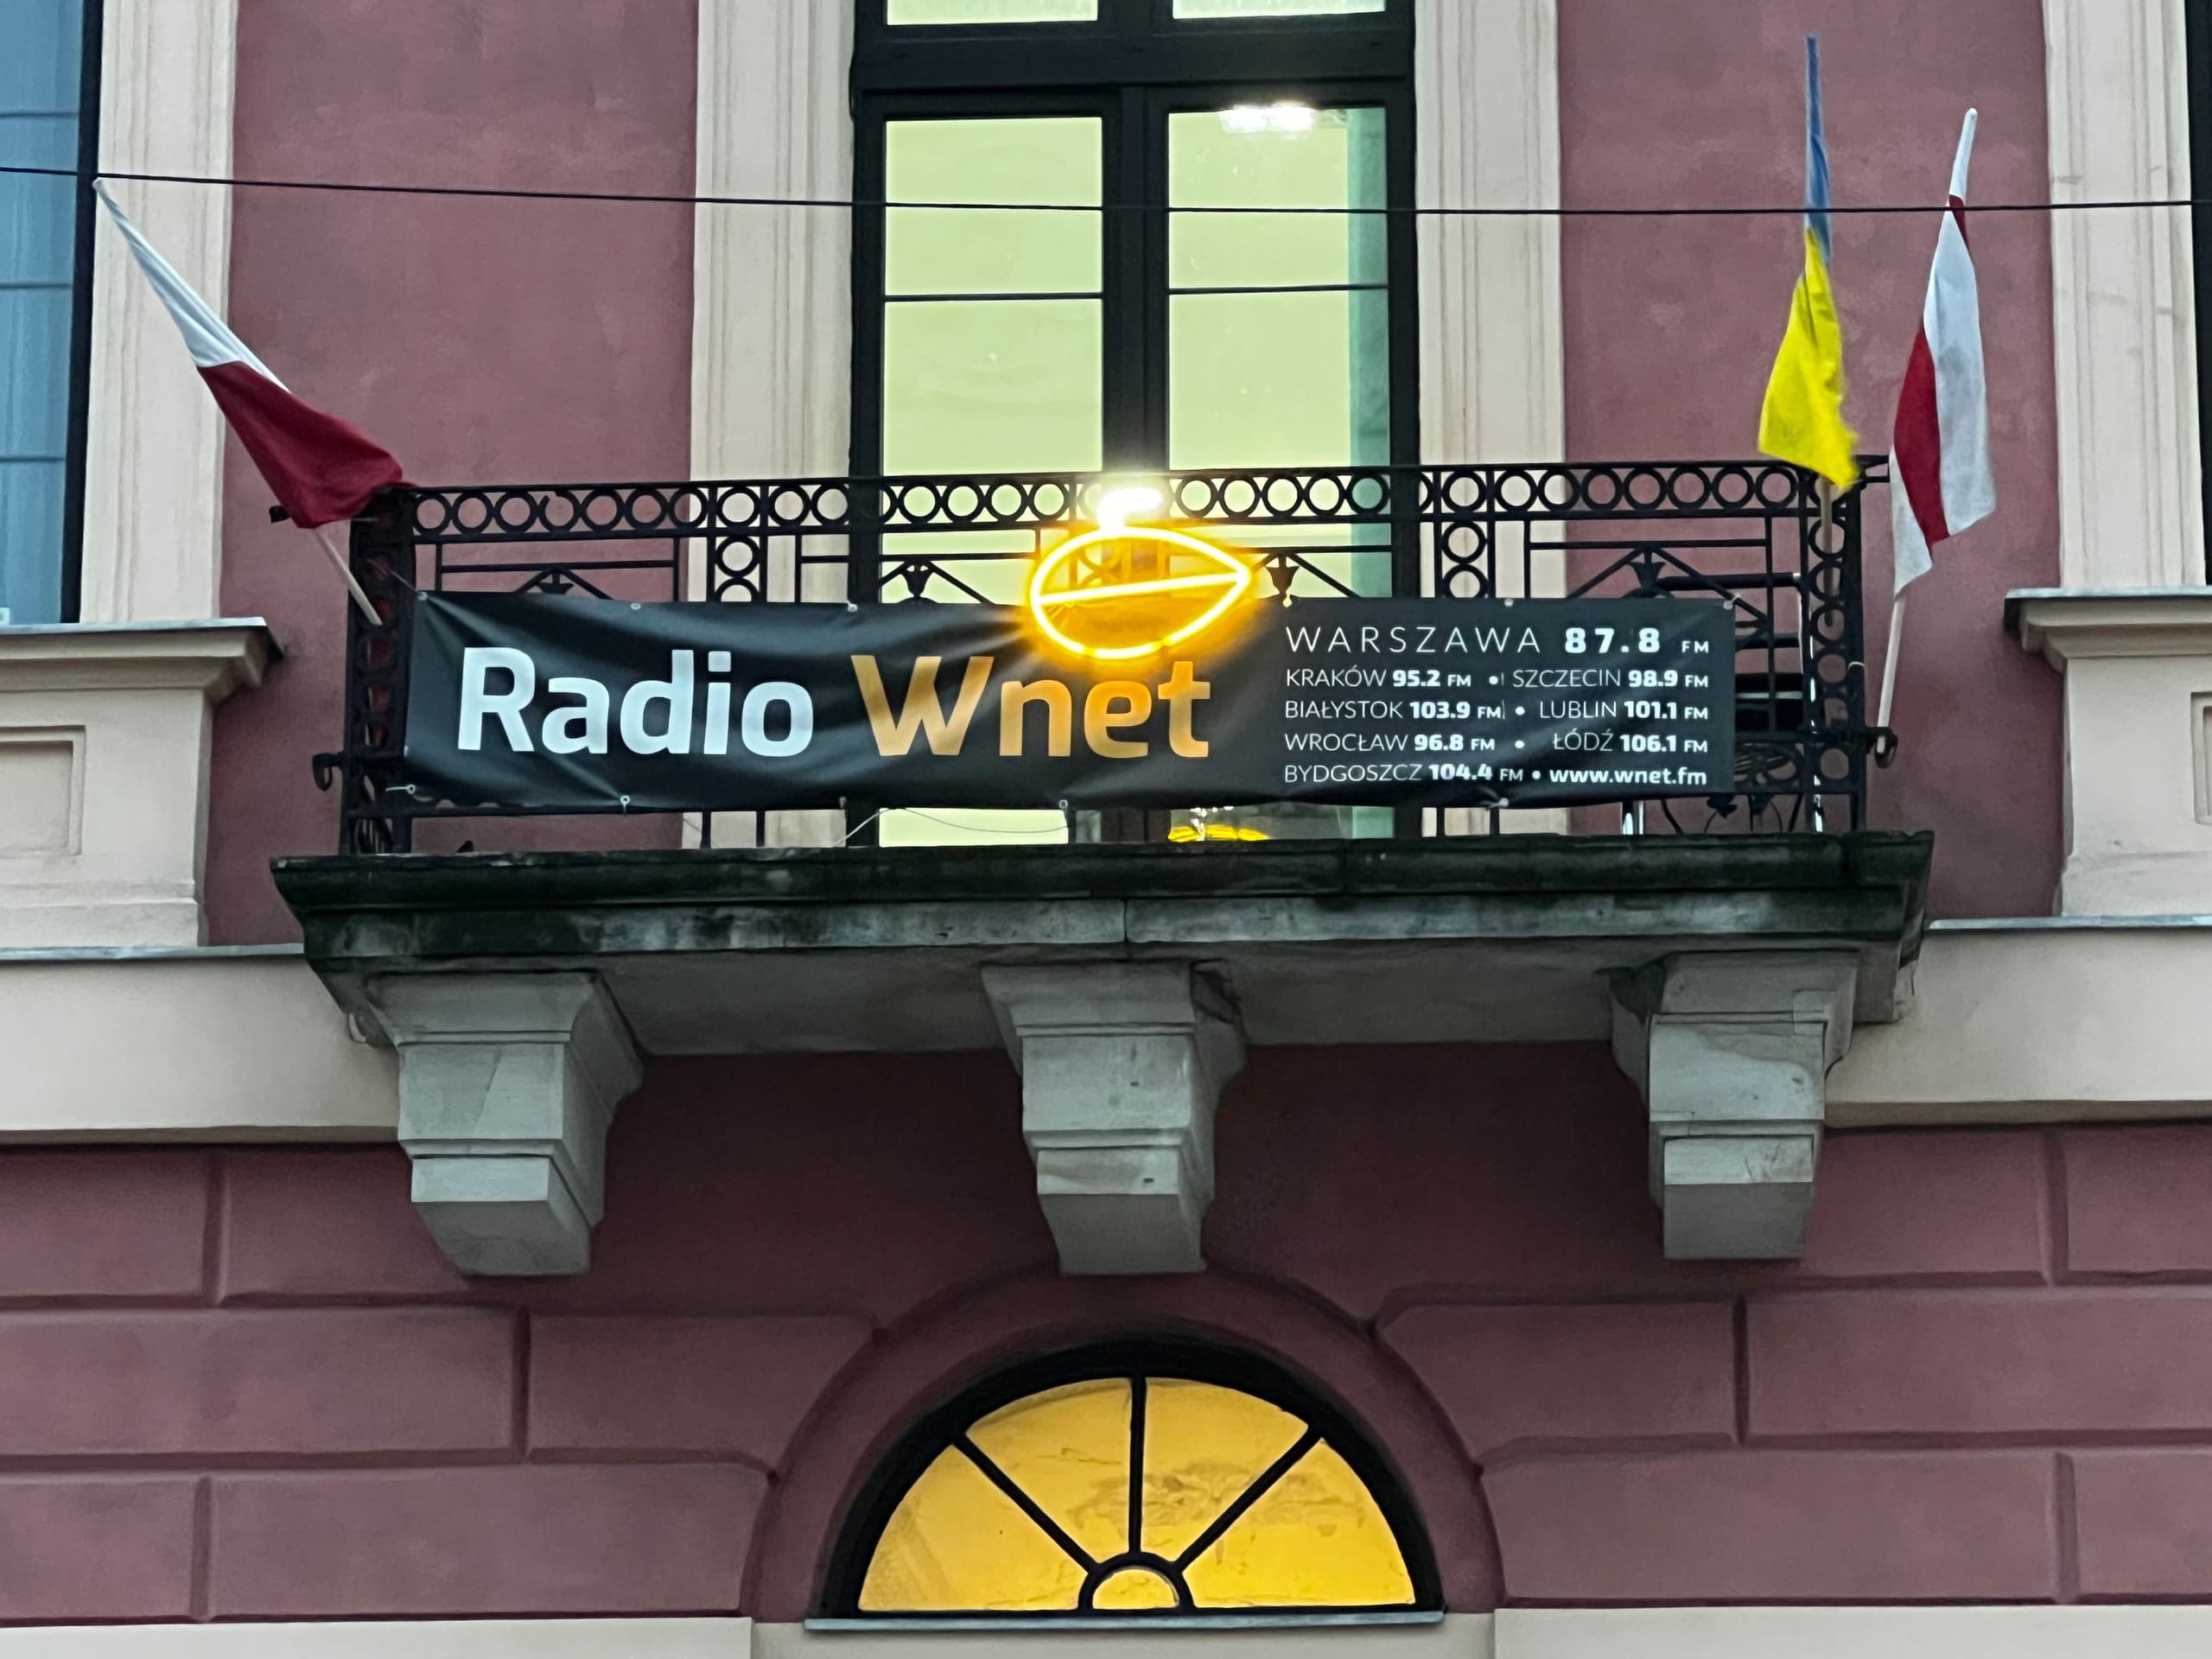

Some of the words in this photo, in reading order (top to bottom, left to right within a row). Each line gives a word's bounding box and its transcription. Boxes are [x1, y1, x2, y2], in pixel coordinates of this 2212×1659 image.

[1286, 626, 1541, 654] WARSZAWA
[1564, 626, 1661, 654] 87.8
[1681, 639, 1709, 654] FM
[1286, 664, 1386, 688] KRAKÓW
[1393, 670, 1440, 688] 95.2
[1447, 674, 1471, 687] FM
[1513, 669, 1621, 688] SZCZECIN
[1628, 670, 1678, 687] 98.9
[1685, 675, 1708, 688] FM
[457, 646, 813, 758] Radio
[851, 654, 1211, 760] Wnet
[1285, 700, 1402, 719] BIAŁYSTOK
[1409, 702, 1470, 720] 103.9
[1478, 706, 1501, 719] FM
[1540, 701, 1618, 719] LUBLIN
[1624, 702, 1677, 720] 101.1
[1685, 707, 1708, 720] FM
[1285, 733, 1408, 752] WROCŁAW
[1414, 734, 1464, 752] 96.8
[1471, 737, 1495, 751] FM
[1553, 727, 1613, 751] ŁÓDŹ
[1619, 734, 1677, 753] 106.1
[1684, 741, 1708, 753] FM
[1285, 764, 1421, 782] BYDGOSZCZ
[1428, 764, 1492, 781] 104.4
[1500, 768, 1523, 781] FM
[1549, 766, 1707, 786] www.wnet.fm
